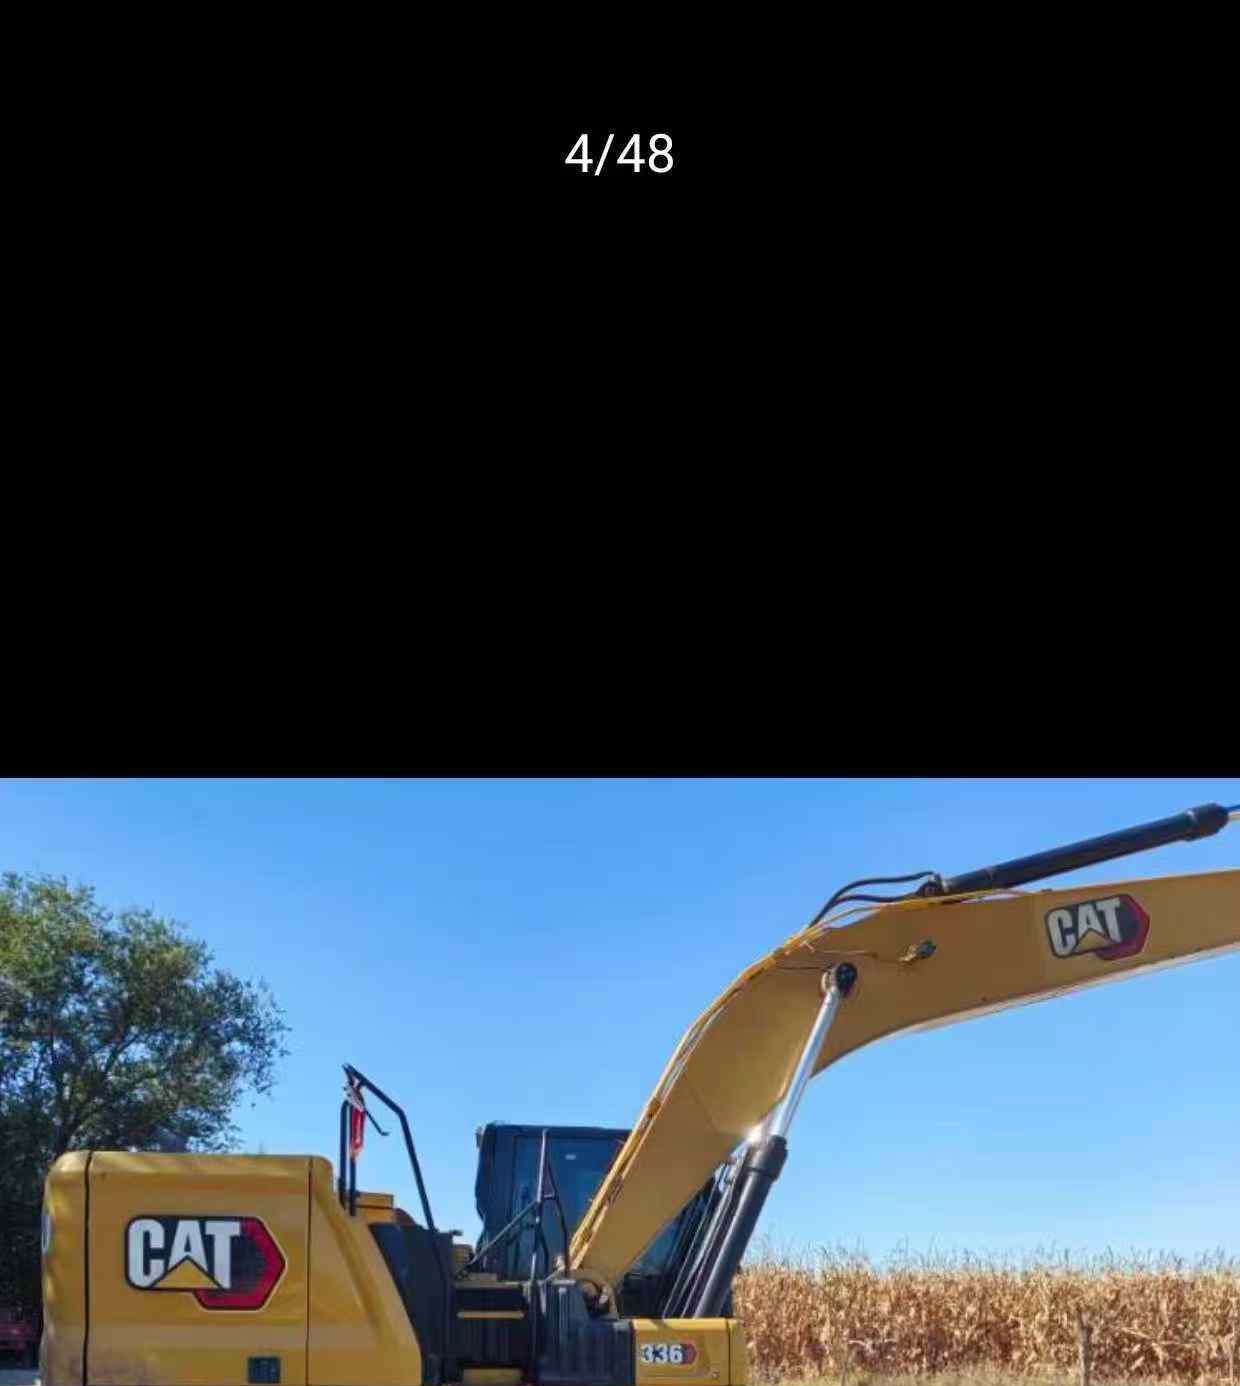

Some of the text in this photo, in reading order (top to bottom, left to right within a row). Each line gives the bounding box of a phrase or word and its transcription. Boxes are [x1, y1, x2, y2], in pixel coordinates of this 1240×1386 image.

[1047, 896, 1122, 956] CAT
[127, 1219, 241, 1289] CAT
[640, 1344, 683, 1365] 336
